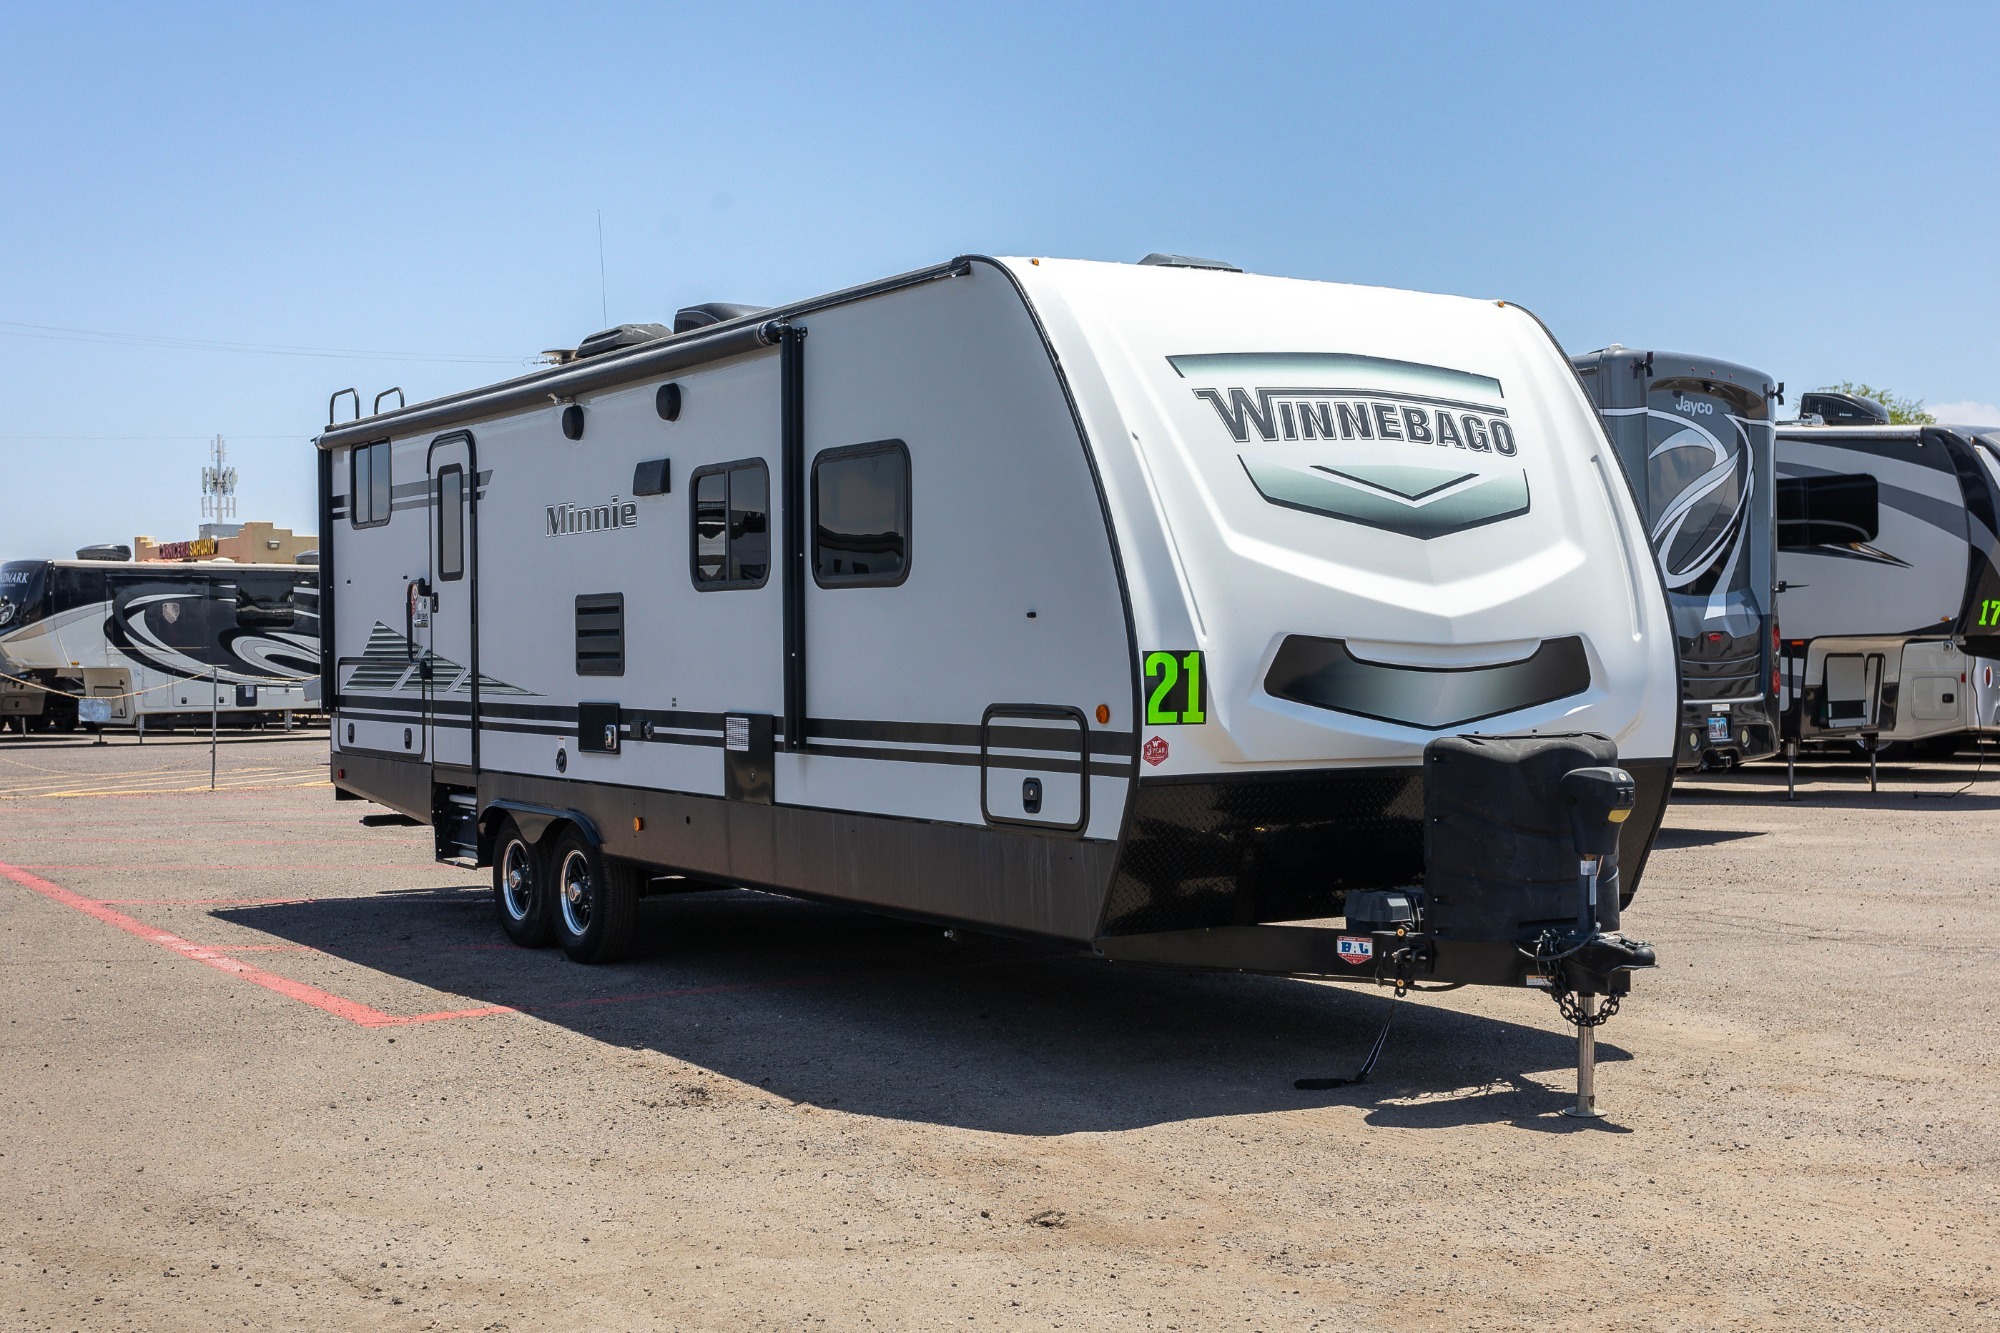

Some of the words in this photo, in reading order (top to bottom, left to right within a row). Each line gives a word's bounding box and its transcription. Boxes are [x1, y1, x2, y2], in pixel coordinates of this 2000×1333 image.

[1192, 387, 1518, 457] WINNEBAGO
[1675, 395, 1713, 417] Jayco
[545, 495, 637, 537] Minnie
[189, 538, 215, 557] SAHUAYO
[1145, 651, 1205, 724] 21
[1146, 744, 1152, 756] 3
[1152, 746, 1166, 754] YEAR
